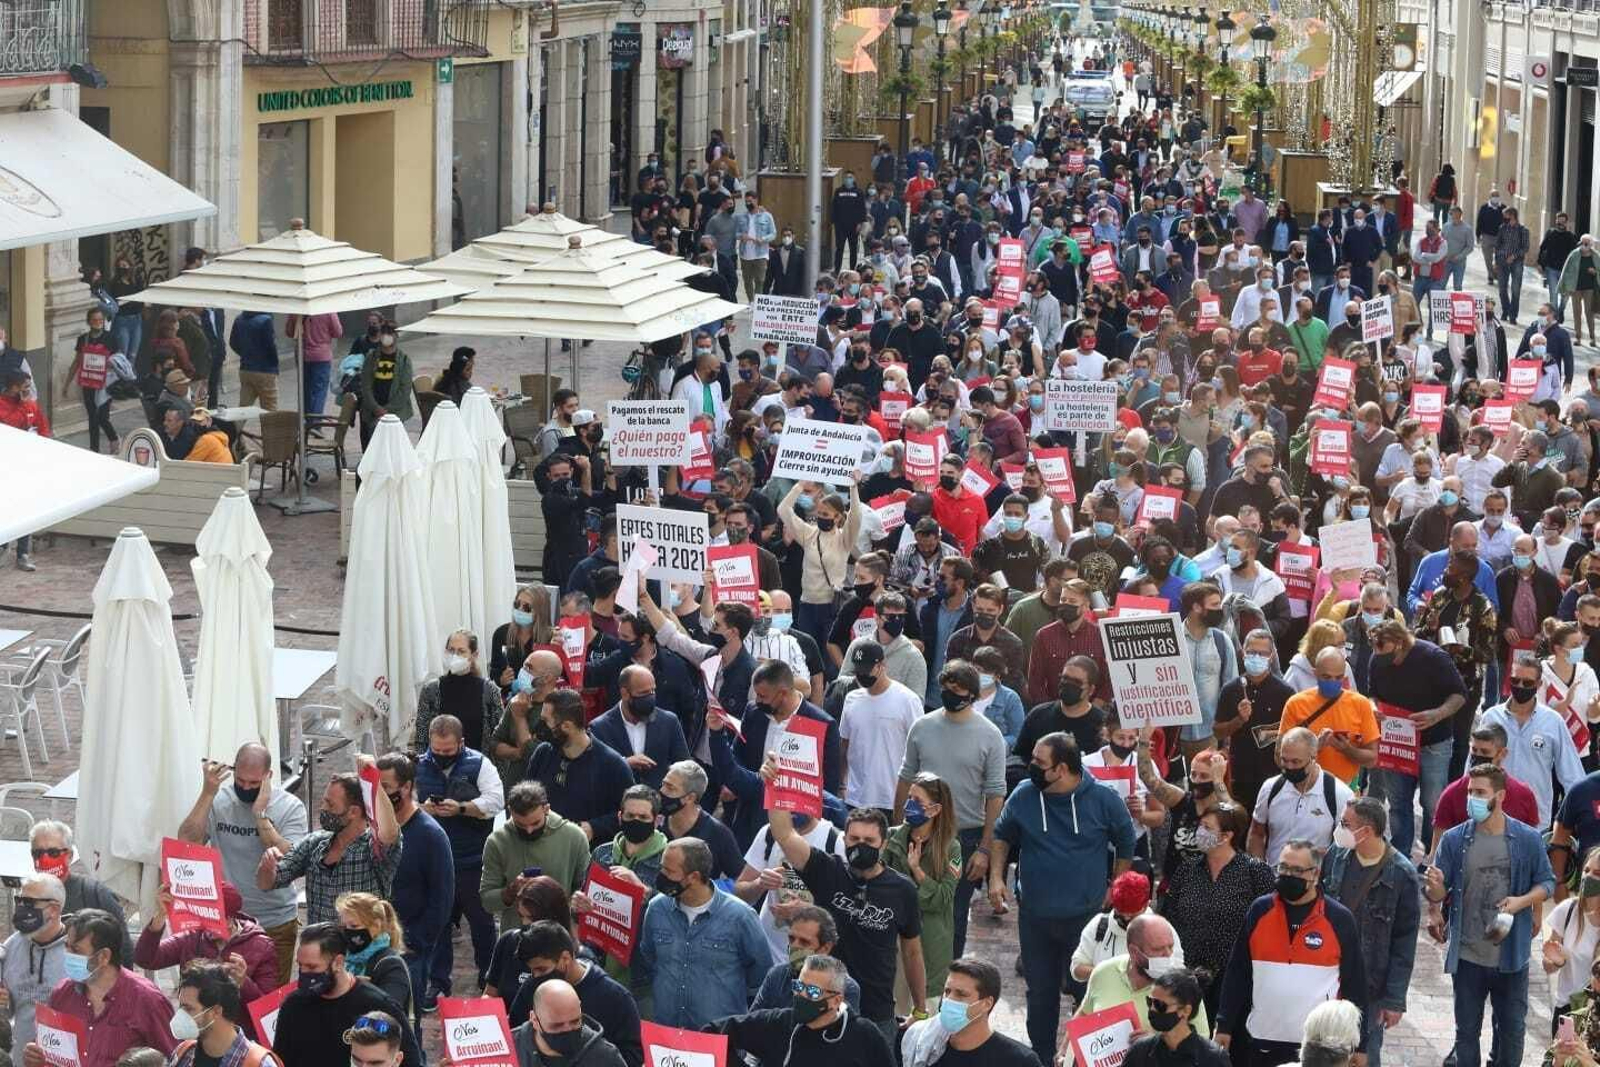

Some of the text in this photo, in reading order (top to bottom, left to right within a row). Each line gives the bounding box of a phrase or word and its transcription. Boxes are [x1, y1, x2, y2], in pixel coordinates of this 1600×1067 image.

[257, 92, 300, 112] UNITED
[301, 86, 343, 108] COLORS
[344, 84, 358, 104] OF
[757, 297, 770, 305] NO
[781, 314, 805, 323] ERTE
[753, 332, 815, 344] TRABAJADORES
[1048, 383, 1060, 392] La
[612, 405, 685, 417] Pagamos el rescate
[1054, 402, 1064, 410] La
[627, 416, 671, 425] de la banca
[1053, 417, 1063, 427] la
[1057, 411, 1106, 420] es parte de
[612, 430, 686, 445] ¿Quién paga
[787, 425, 862, 442] Junta de Andalucía
[618, 444, 629, 457] el
[631, 445, 683, 457] nuestro?
[781, 449, 856, 467] IMPROVISACIÓN
[779, 460, 805, 471] Cierre
[807, 463, 820, 473] sin
[621, 519, 704, 545] ERTES TOTALES
[671, 547, 705, 572] 2021
[1109, 620, 1172, 638] Restricciones
[1111, 637, 1177, 659] injustas
[1155, 662, 1179, 681] sin
[790, 777, 820, 797] AYUDAS
[585, 914, 630, 946] SIN AYUDAS
[456, 1039, 505, 1058] Arruinan!
